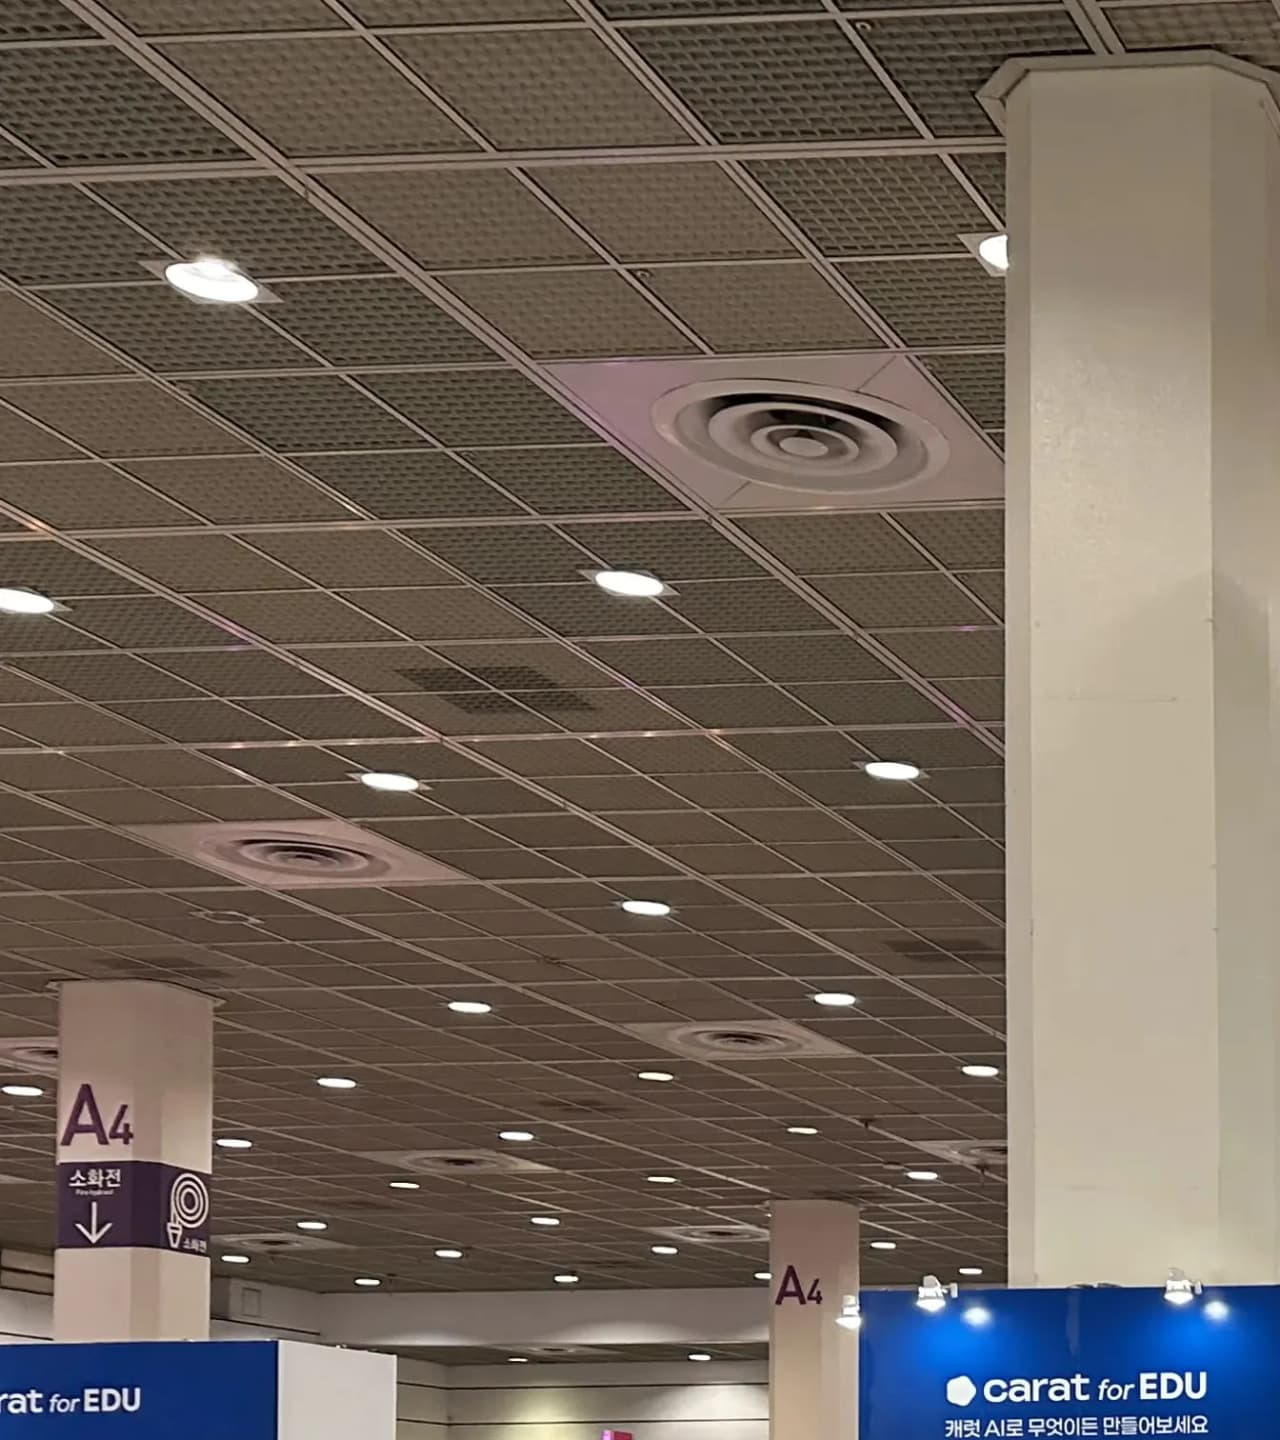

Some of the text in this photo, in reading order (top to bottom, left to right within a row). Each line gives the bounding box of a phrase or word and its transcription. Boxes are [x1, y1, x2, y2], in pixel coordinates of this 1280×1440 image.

[60, 1083, 134, 1146] A4
[69, 1168, 121, 1188] 소화전
[775, 1265, 823, 1305] A4
[49, 1393, 80, 1413] for
[83, 1387, 141, 1412] EDU
[983, 1371, 1208, 1403] carat for EDU
[944, 1415, 1209, 1439] 캐럿 AI로 무엇이든 만들어보세요
